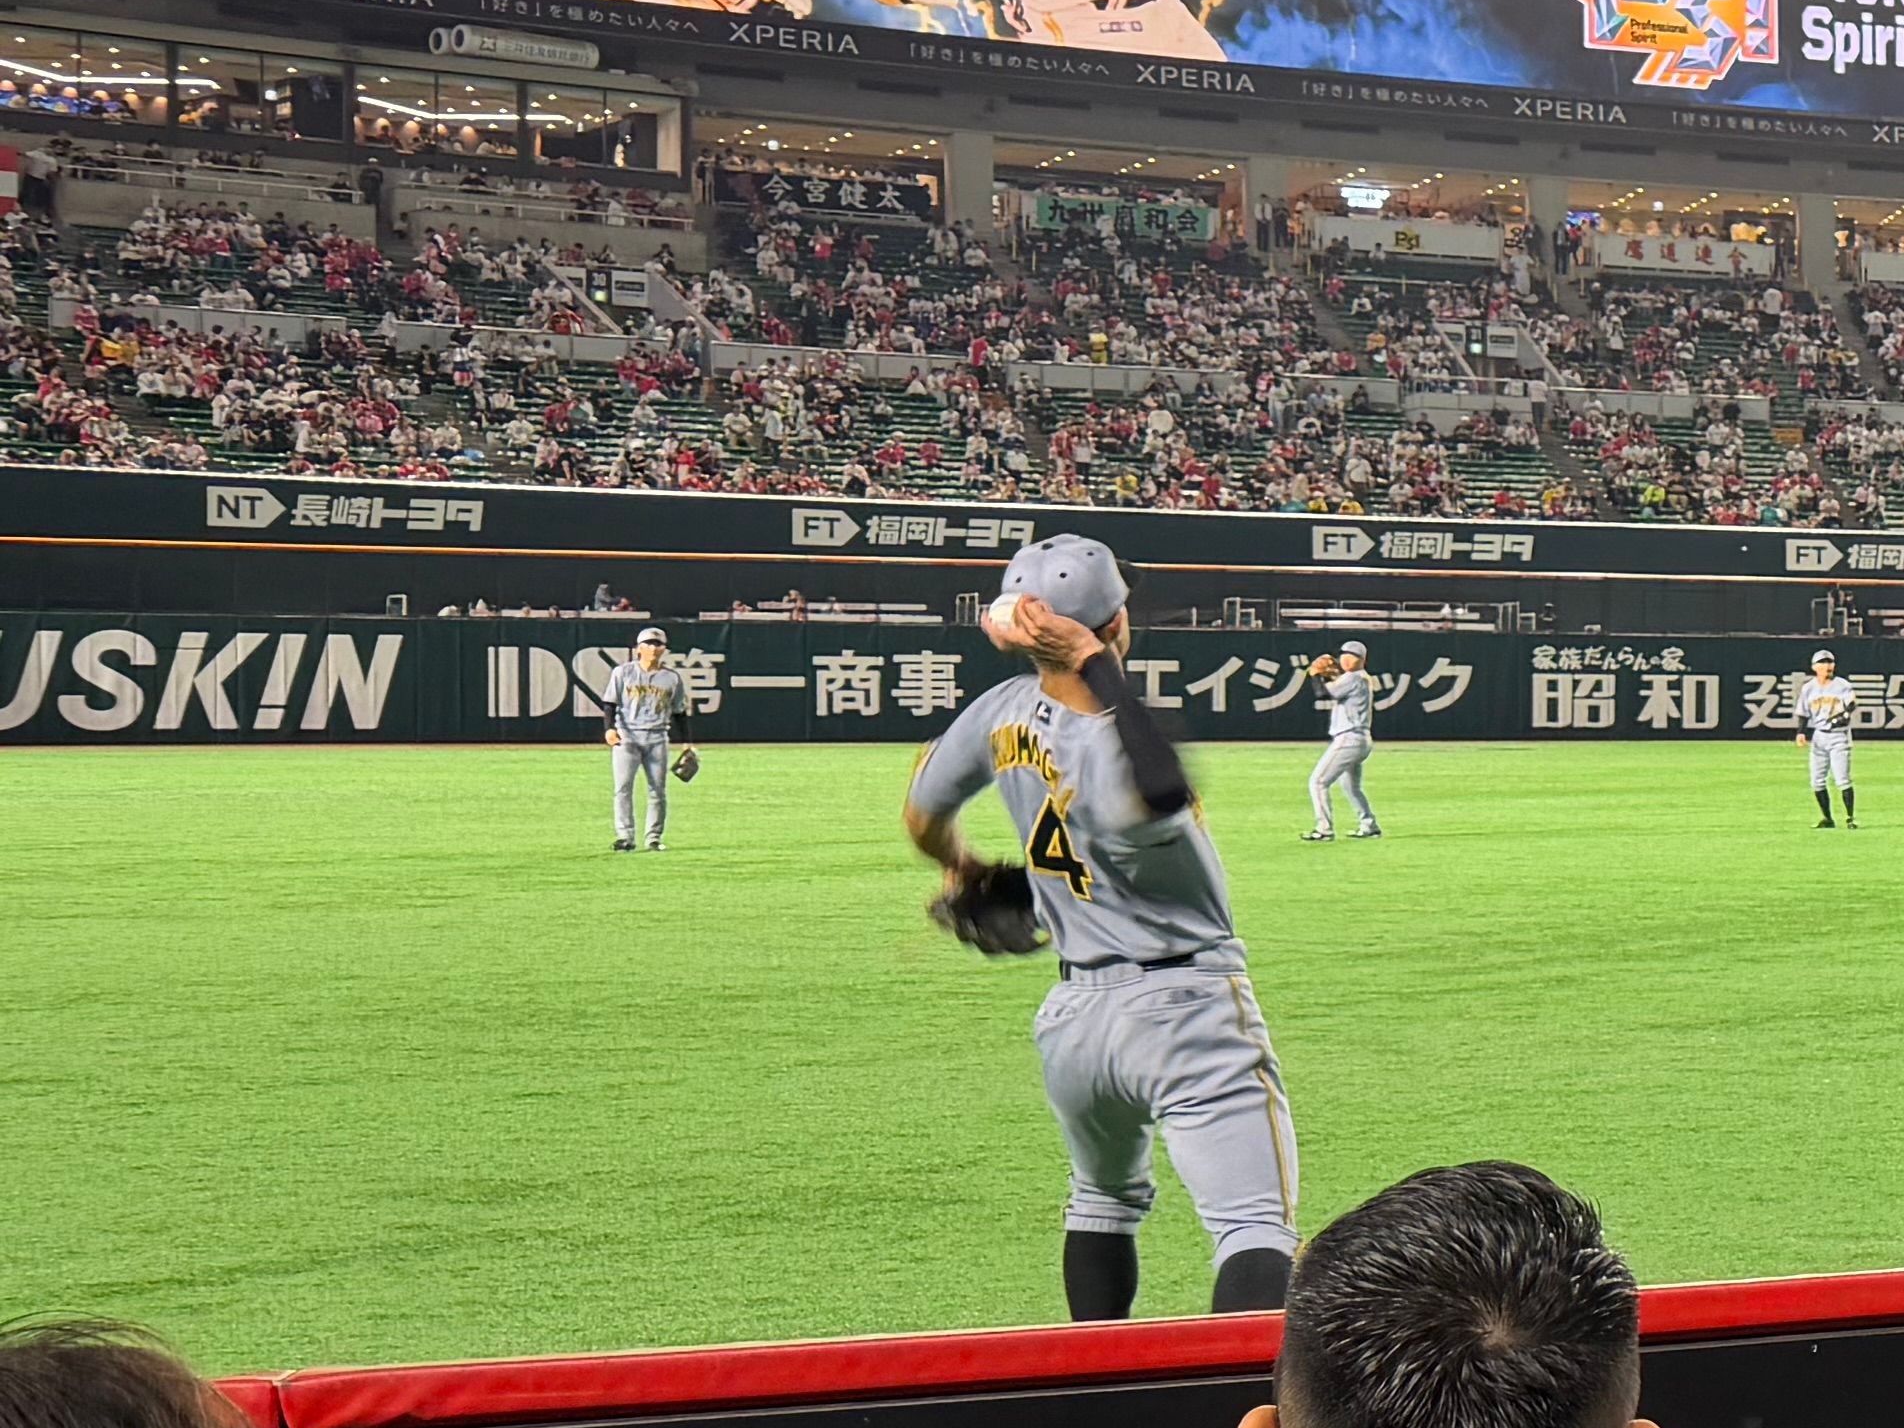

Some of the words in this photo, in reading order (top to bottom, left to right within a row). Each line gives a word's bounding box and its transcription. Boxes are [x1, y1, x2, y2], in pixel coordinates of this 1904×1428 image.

[729, 21, 860, 56] XPERIA
[1135, 63, 1256, 94] XPERIA
[1512, 96, 1628, 125] XPERIA
[762, 173, 903, 210] 今宮健太
[215, 495, 264, 522] NT
[290, 493, 484, 532] 長崎トヨタ
[800, 517, 840, 539] FT
[866, 515, 1034, 549] 福岡トヨタ
[1320, 534, 1357, 555] FT
[1379, 531, 1534, 562] 福岡トヨタ
[1796, 545, 1830, 564] FT
[1128, 654, 1474, 714] エイジック
[1025, 794, 1094, 901] 4
